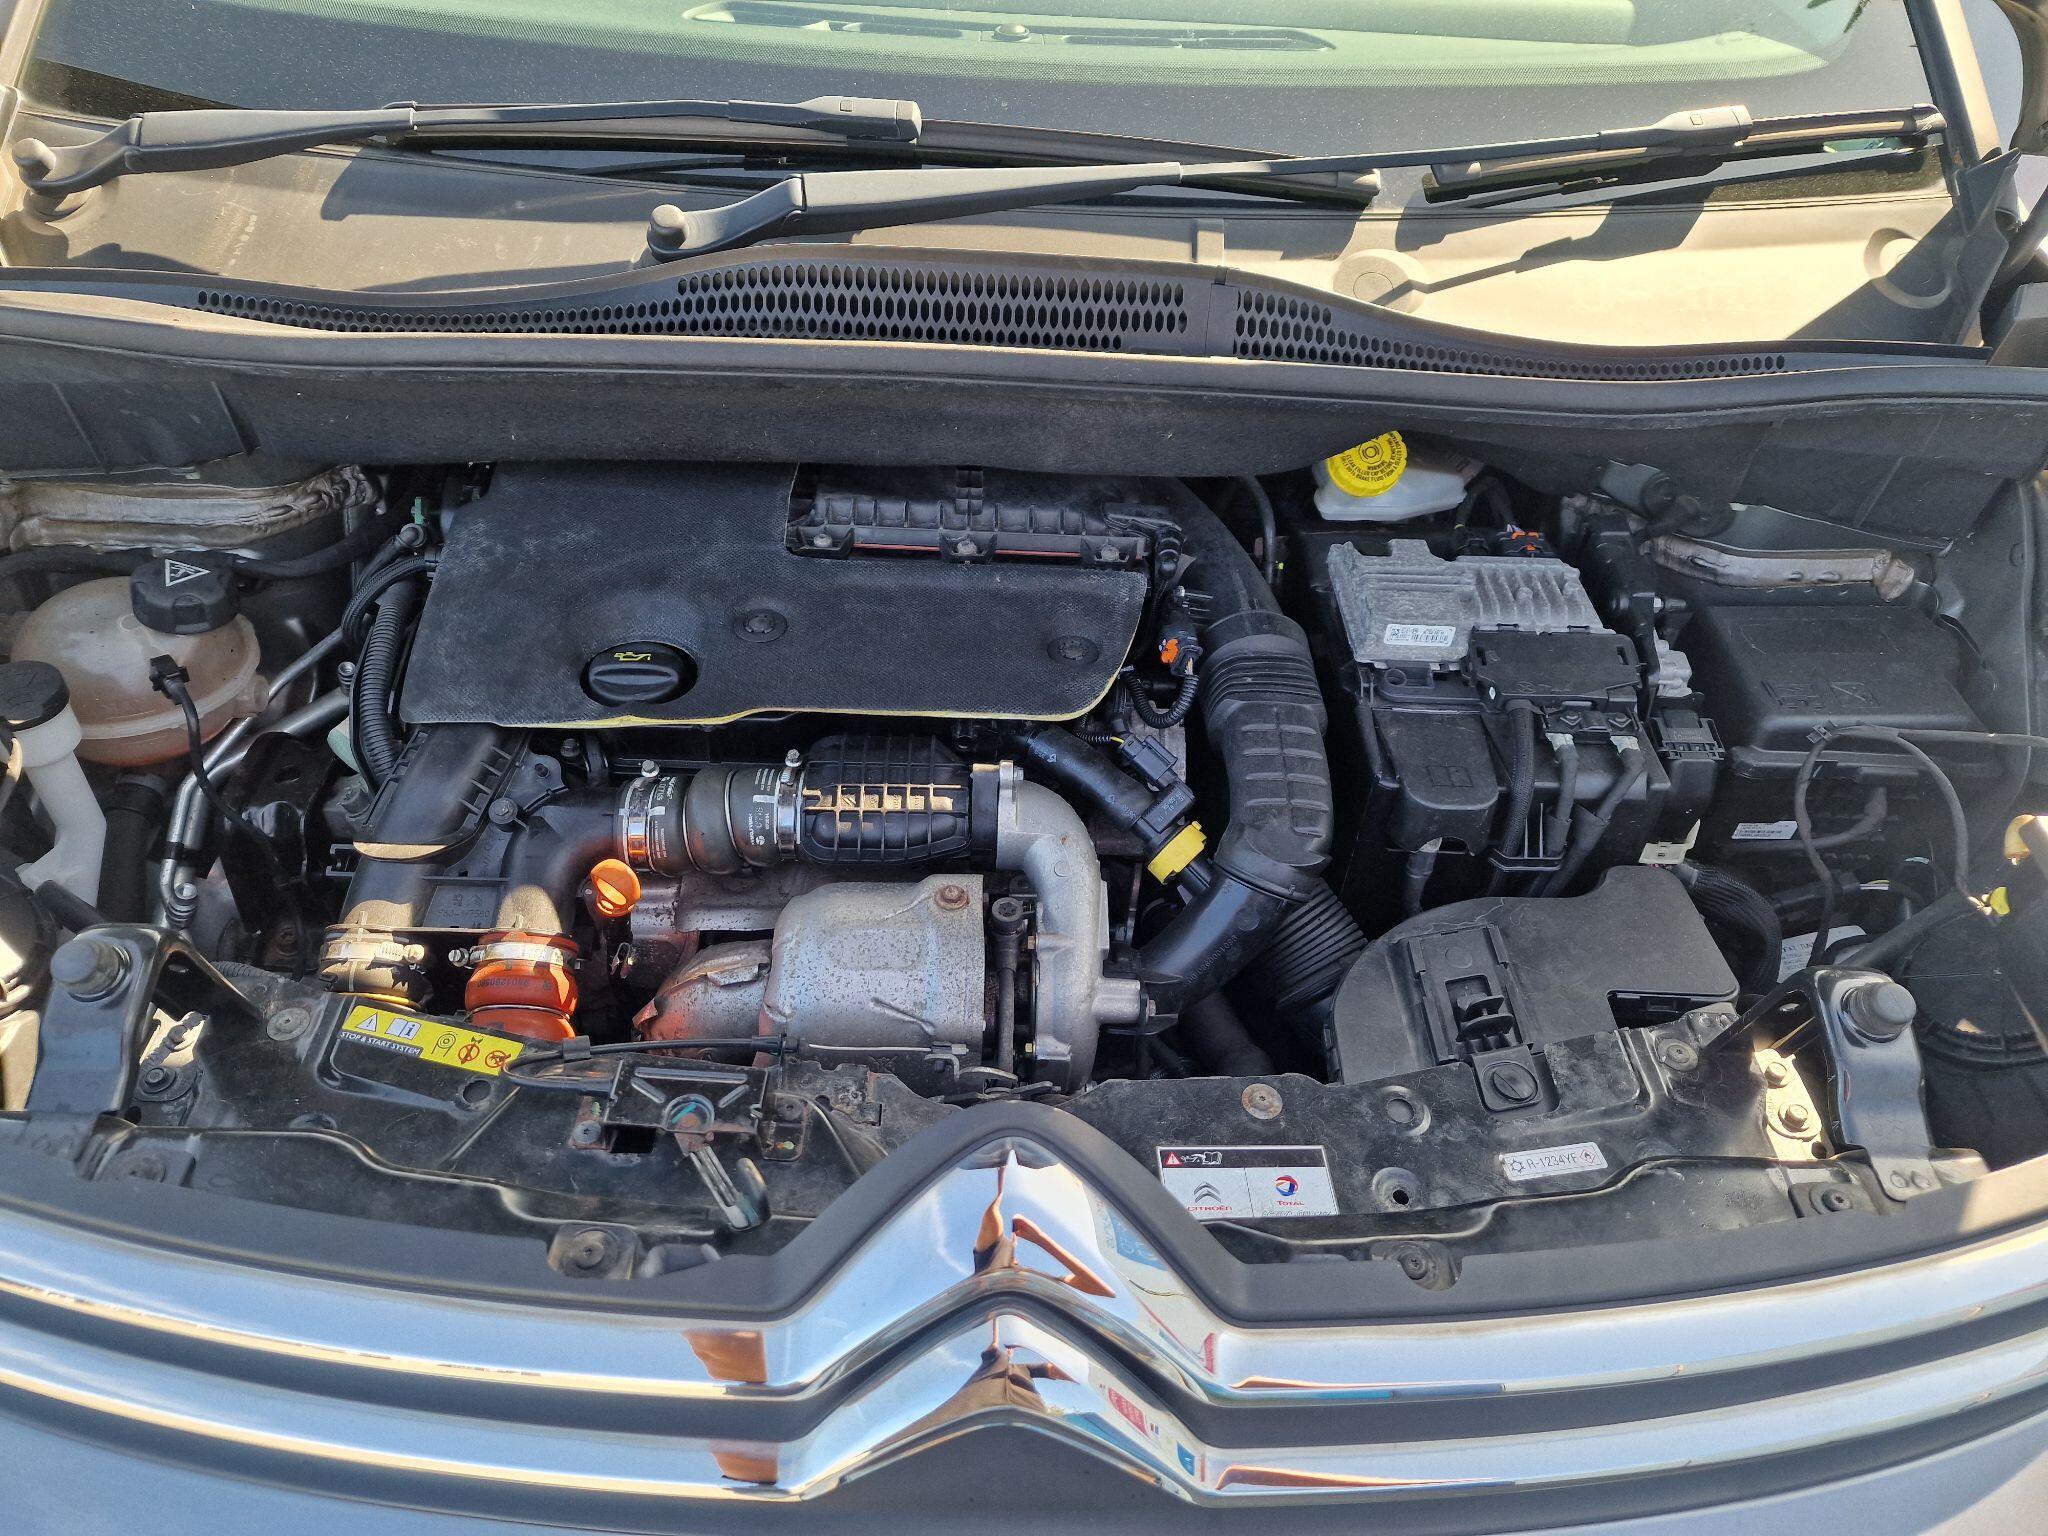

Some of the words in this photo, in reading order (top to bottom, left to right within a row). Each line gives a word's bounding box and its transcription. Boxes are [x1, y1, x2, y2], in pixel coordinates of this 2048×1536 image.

[340, 1032, 360, 1041] STOP
[367, 1037, 390, 1048] START
[391, 1043, 420, 1054] SYSTEM
[1527, 1153, 1576, 1169] R-1234YF
